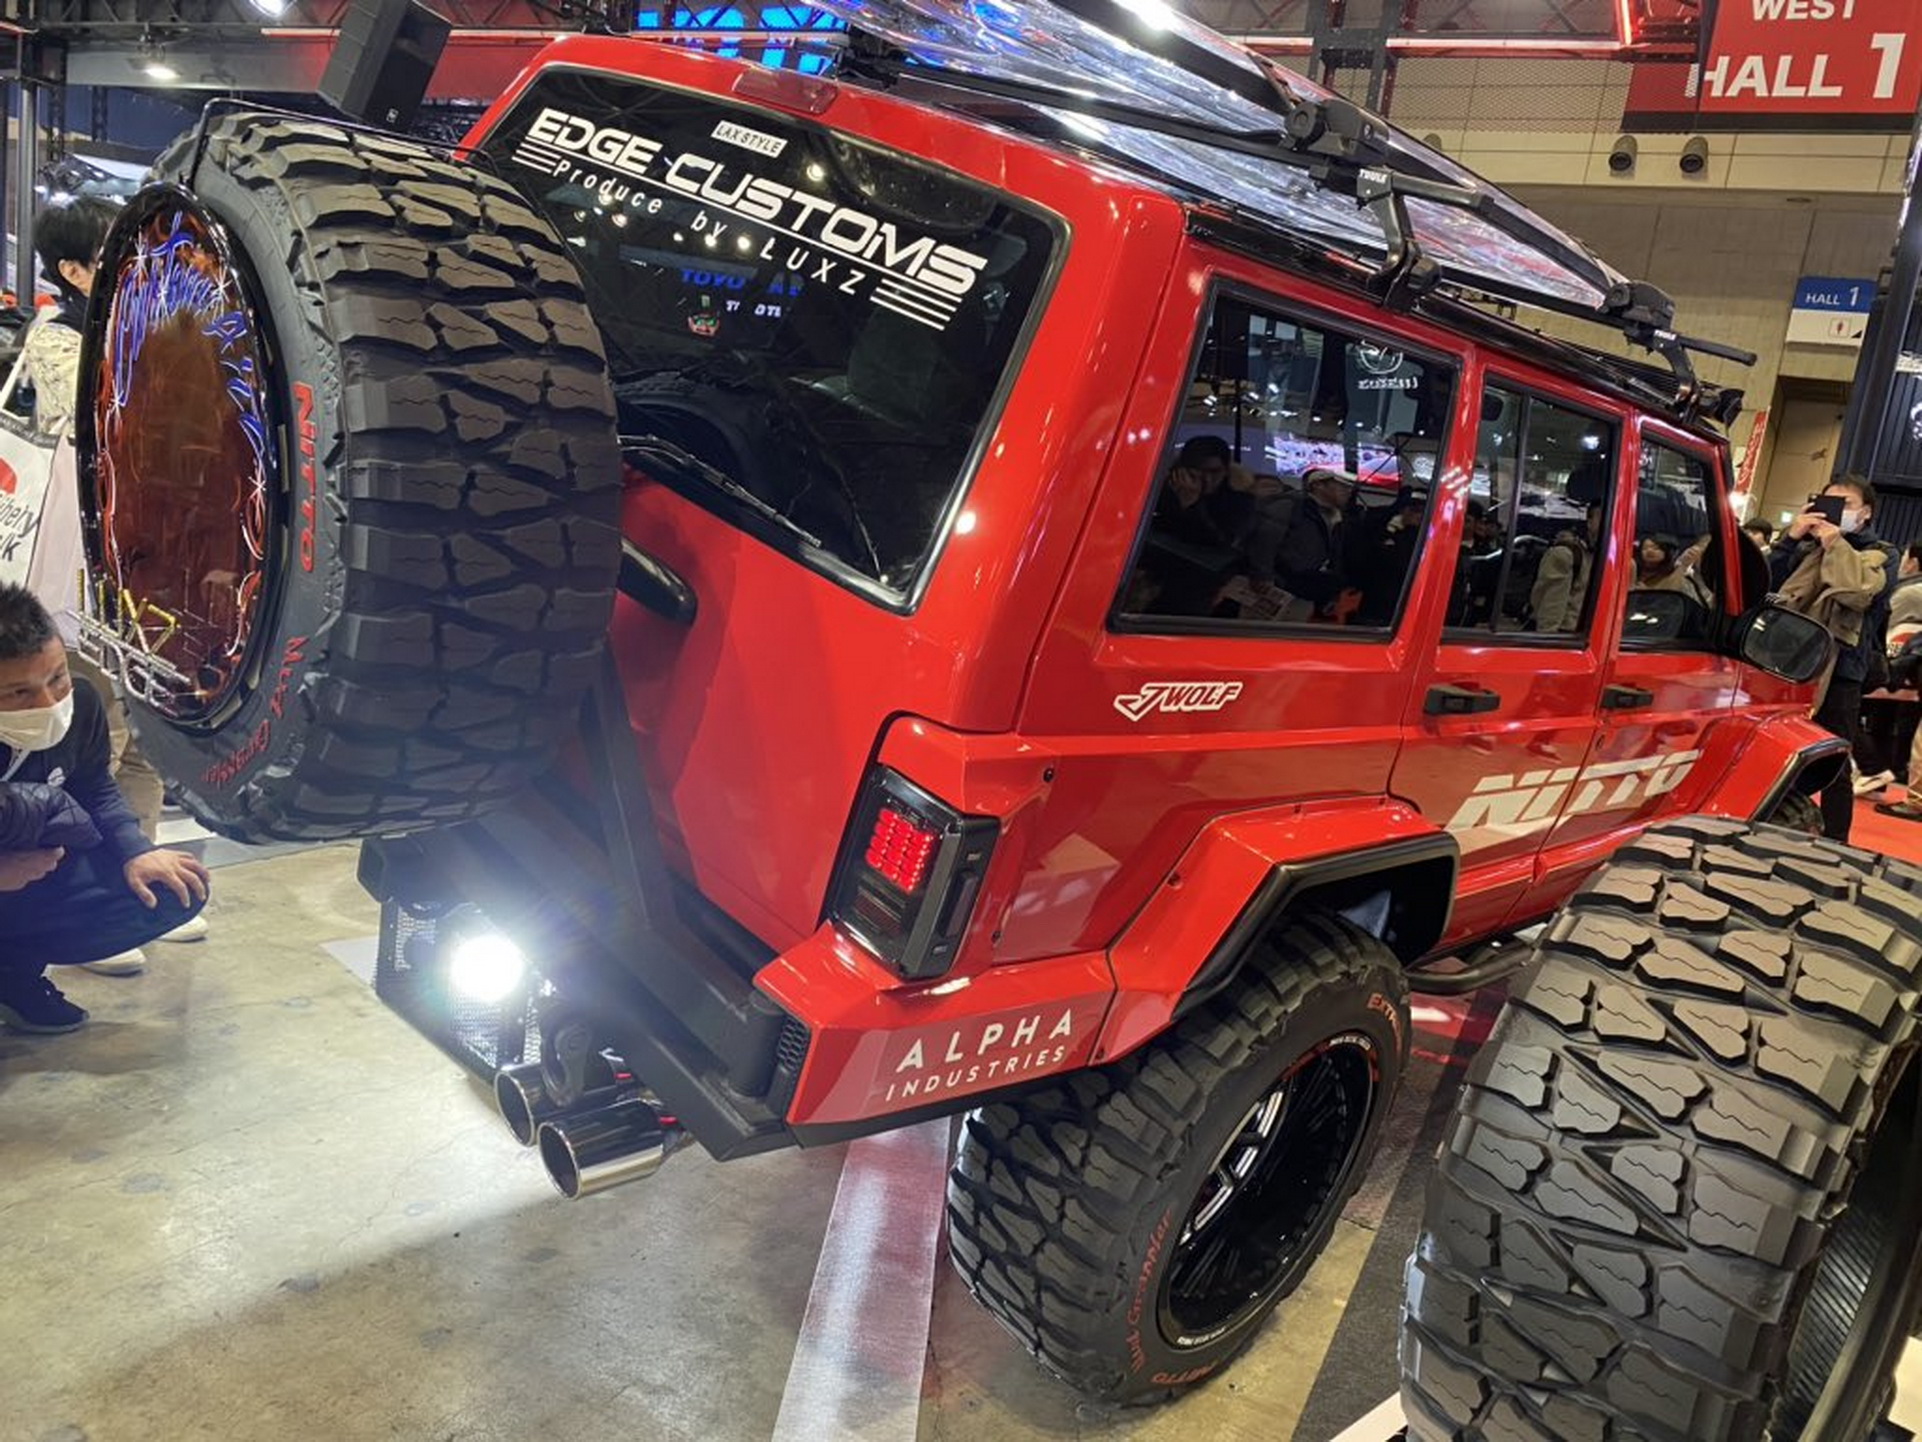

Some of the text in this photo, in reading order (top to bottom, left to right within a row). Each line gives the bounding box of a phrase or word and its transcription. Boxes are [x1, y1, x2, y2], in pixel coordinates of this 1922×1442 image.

[1752, 0, 1856, 21] WEST
[1703, 32, 1907, 99] HALL 1
[526, 107, 989, 296] EDGE CUSTOMS
[552, 159, 663, 214] Produce
[690, 209, 728, 240] by
[760, 237, 867, 296] LUXZ
[1805, 286, 1860, 307] HALL 1
[293, 381, 317, 573] NITTO
[1444, 749, 1702, 831] NITTO
[885, 1045, 1065, 1102] INDUSTRIES
[896, 1008, 1072, 1073] ALPHA
